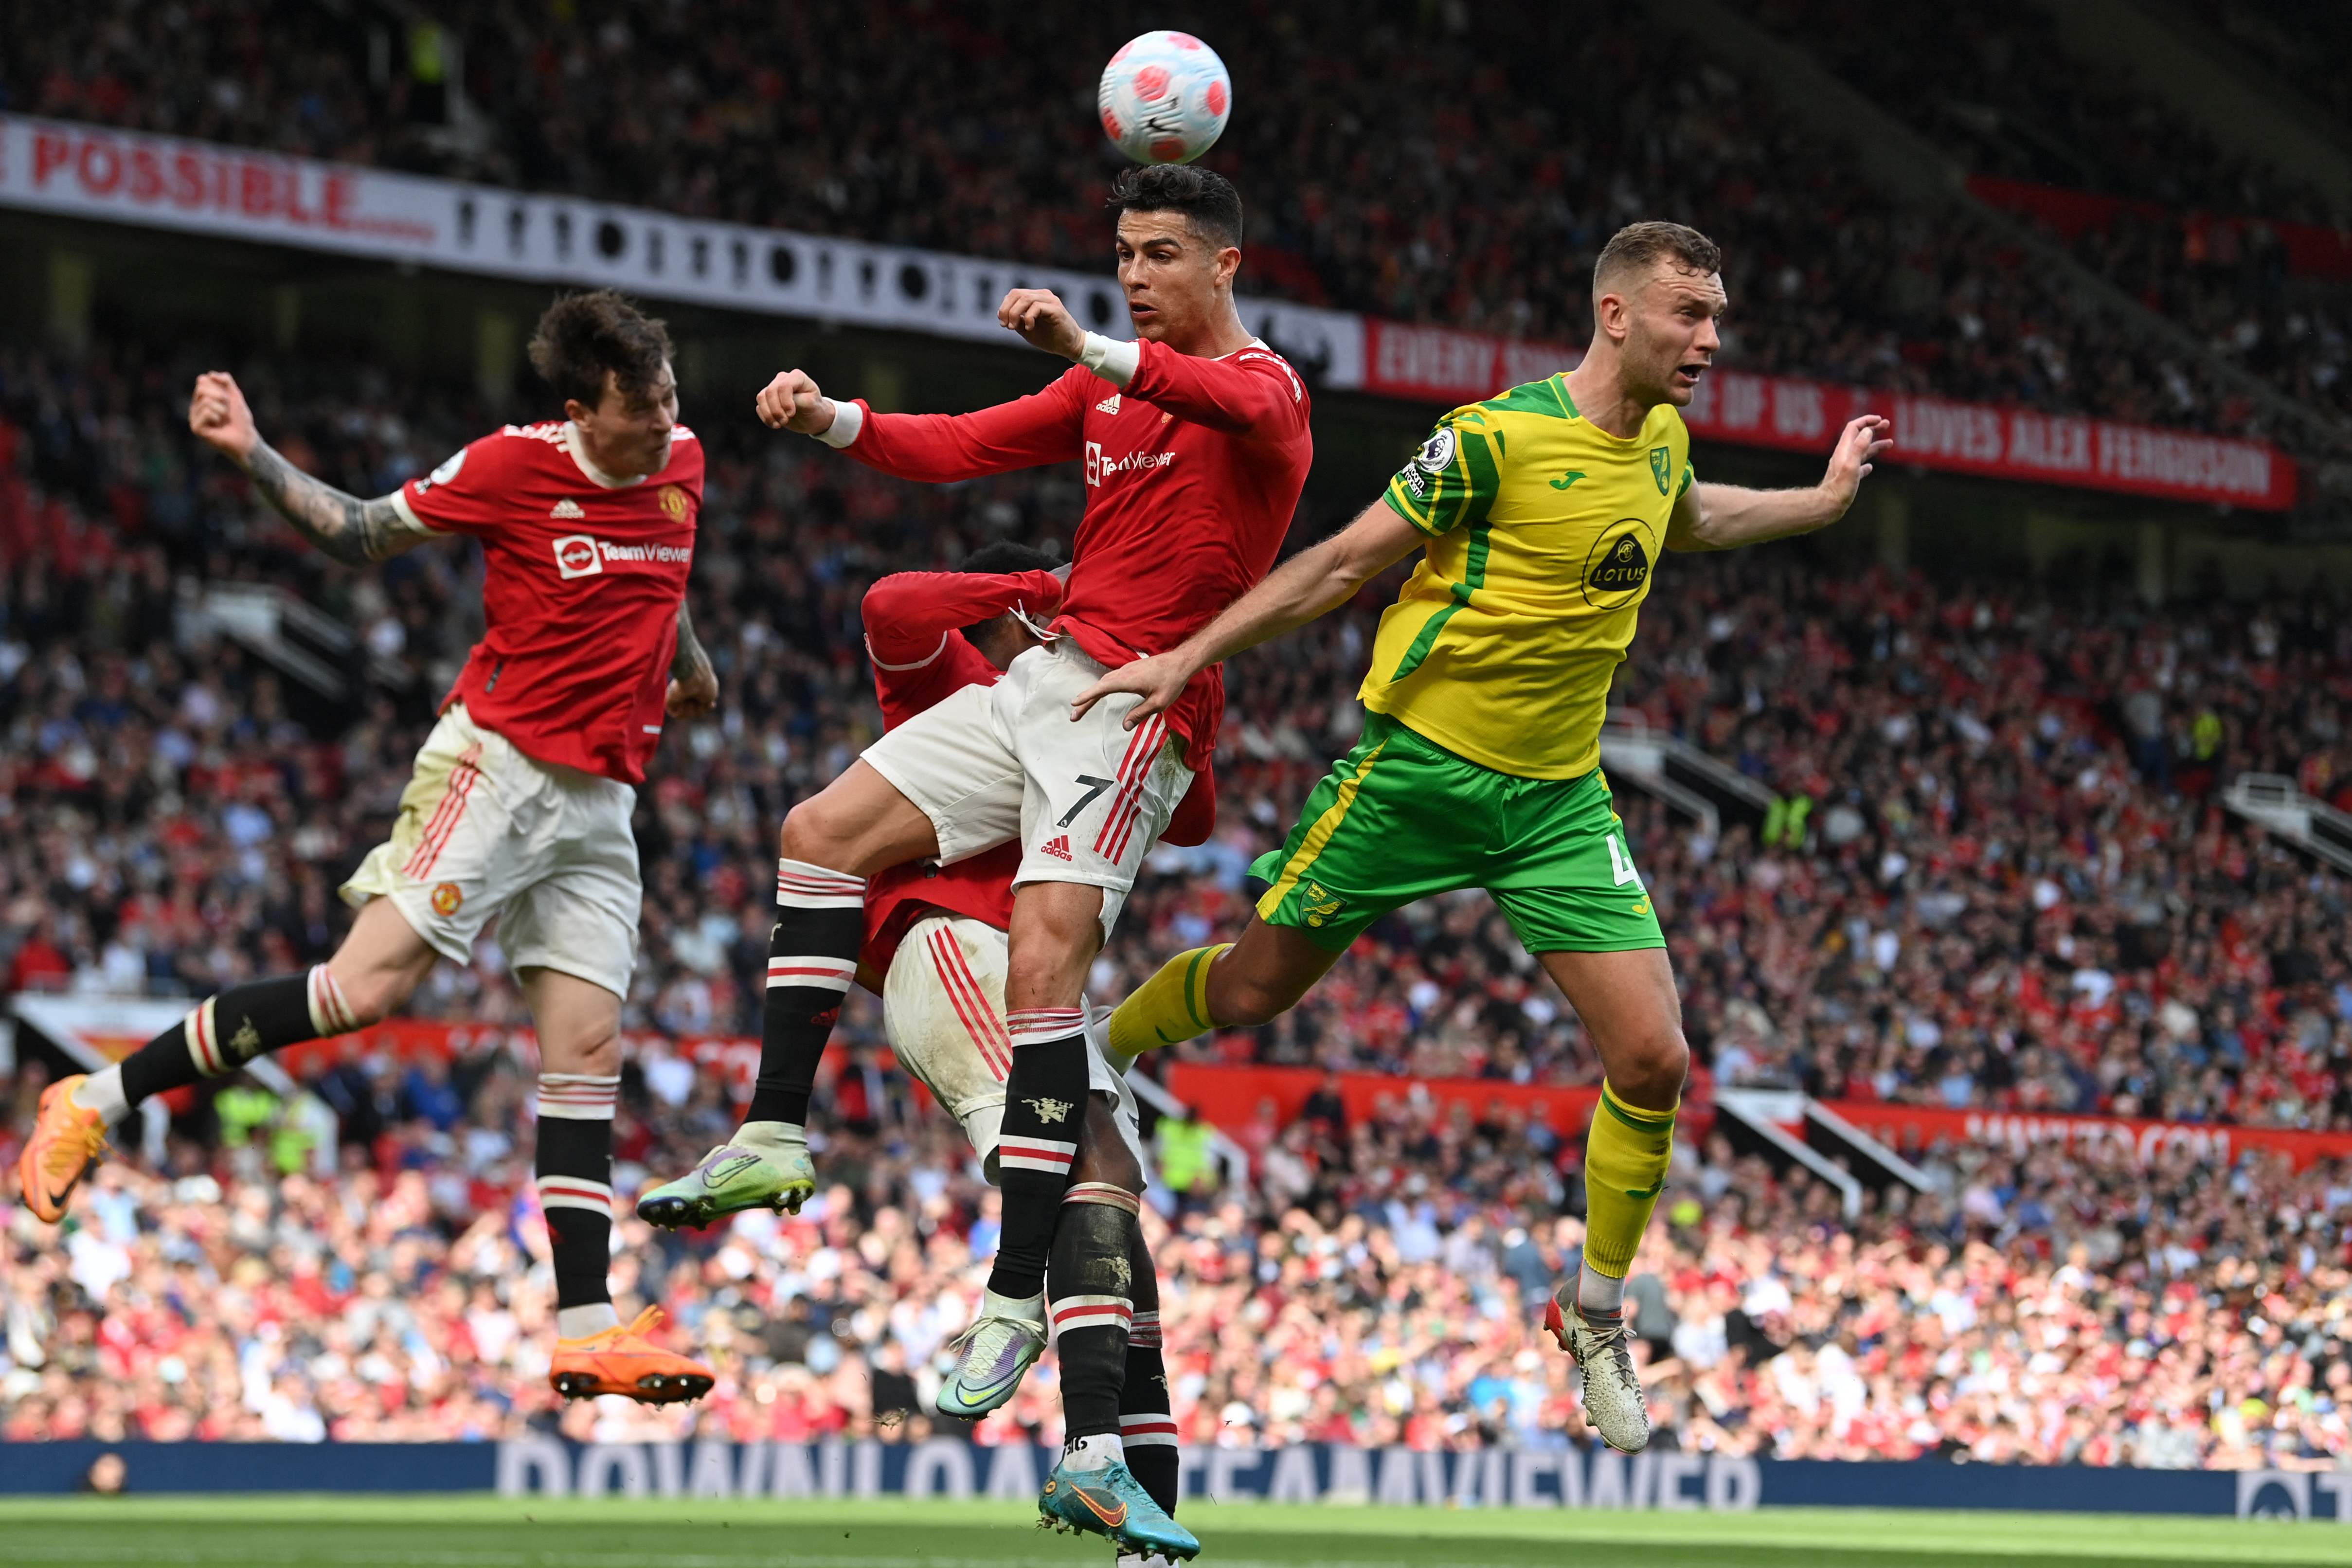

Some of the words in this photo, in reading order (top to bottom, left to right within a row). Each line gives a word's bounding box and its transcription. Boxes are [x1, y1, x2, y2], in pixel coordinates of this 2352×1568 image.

[1095, 403, 1119, 415] adida
[1774, 381, 1824, 439] US
[1101, 451, 1175, 476] TemViewer
[1594, 567, 1646, 582] LOTUS
[1056, 775, 1115, 828] 7
[1041, 846, 1073, 862] adidas
[1605, 833, 1644, 892] 4
[495, 1433, 1065, 1499] DOWNLOA
